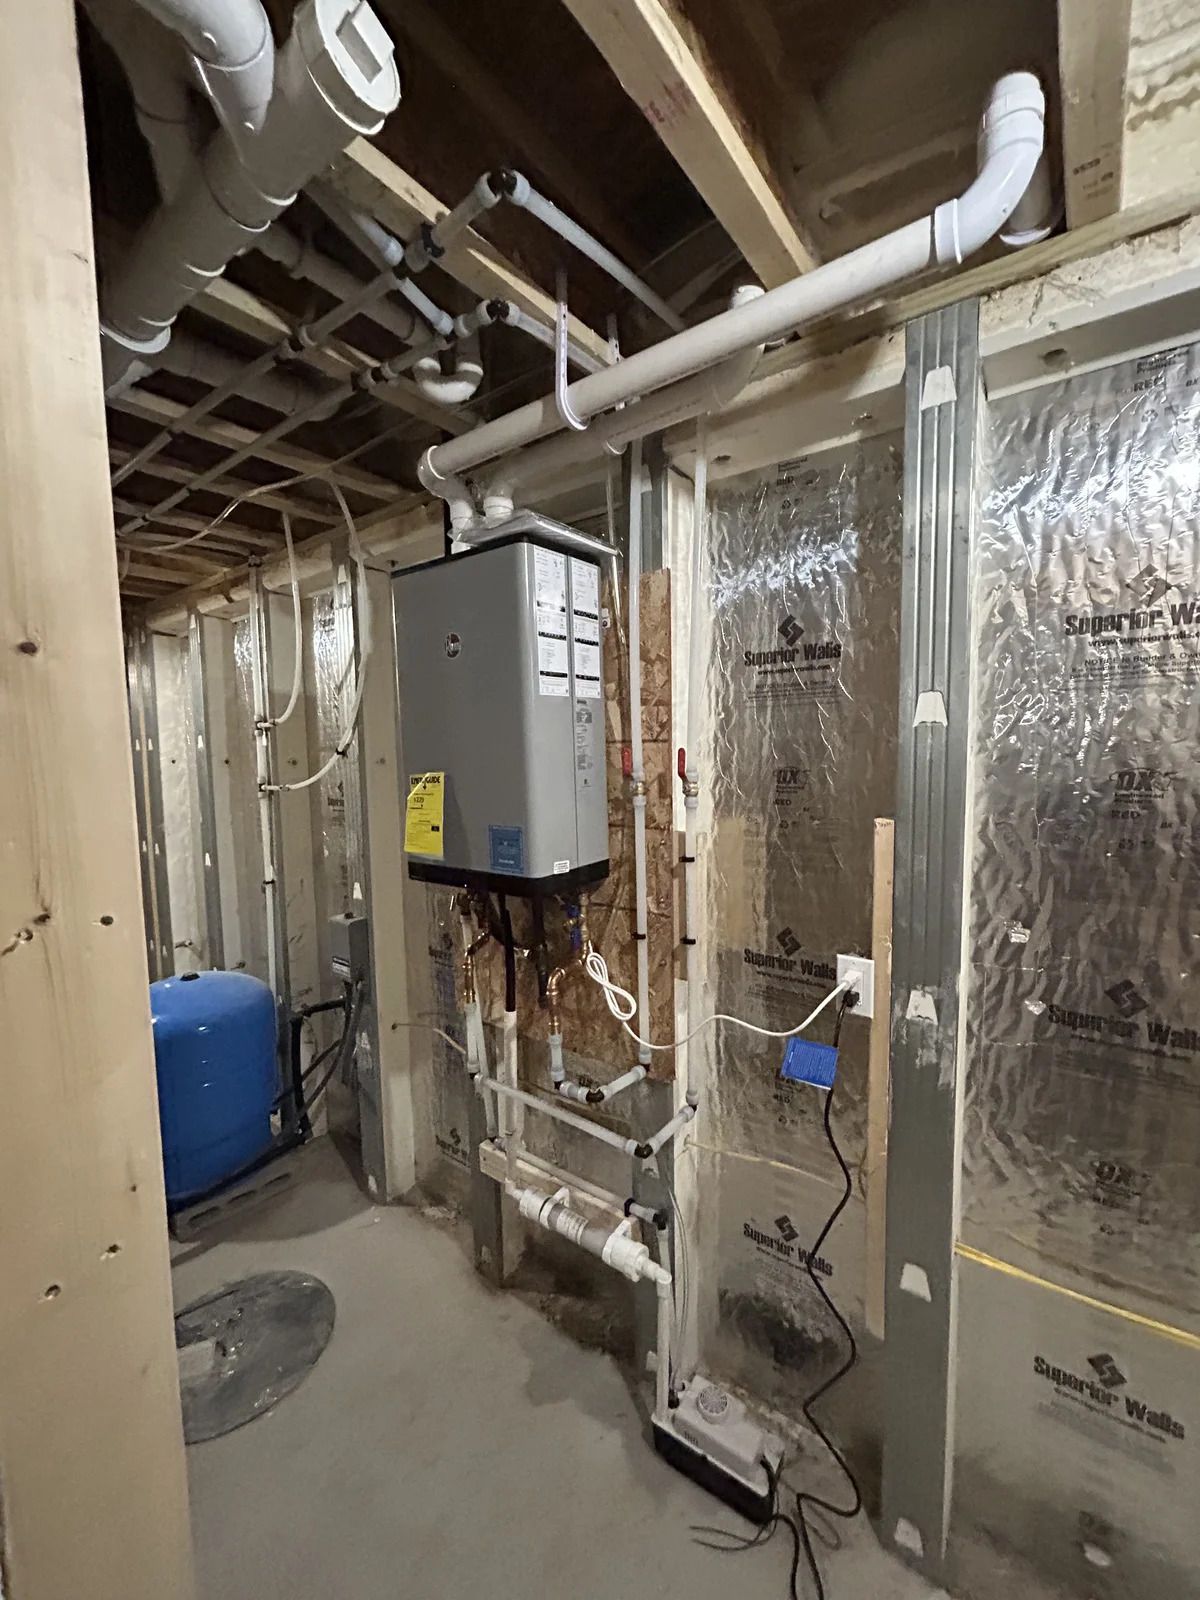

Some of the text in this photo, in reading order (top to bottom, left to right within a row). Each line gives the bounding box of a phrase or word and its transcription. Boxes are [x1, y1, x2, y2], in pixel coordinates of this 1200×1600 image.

[1065, 608, 1163, 637] Superior
[744, 641, 842, 668] Superior Walls
[744, 948, 836, 980] Superior Walls
[1048, 1004, 1140, 1038] Superior
[743, 1222, 795, 1257] Superior
[798, 1247, 833, 1276] Walls
[1033, 1355, 1119, 1406] Superior
[1124, 1395, 1185, 1440] Walls
